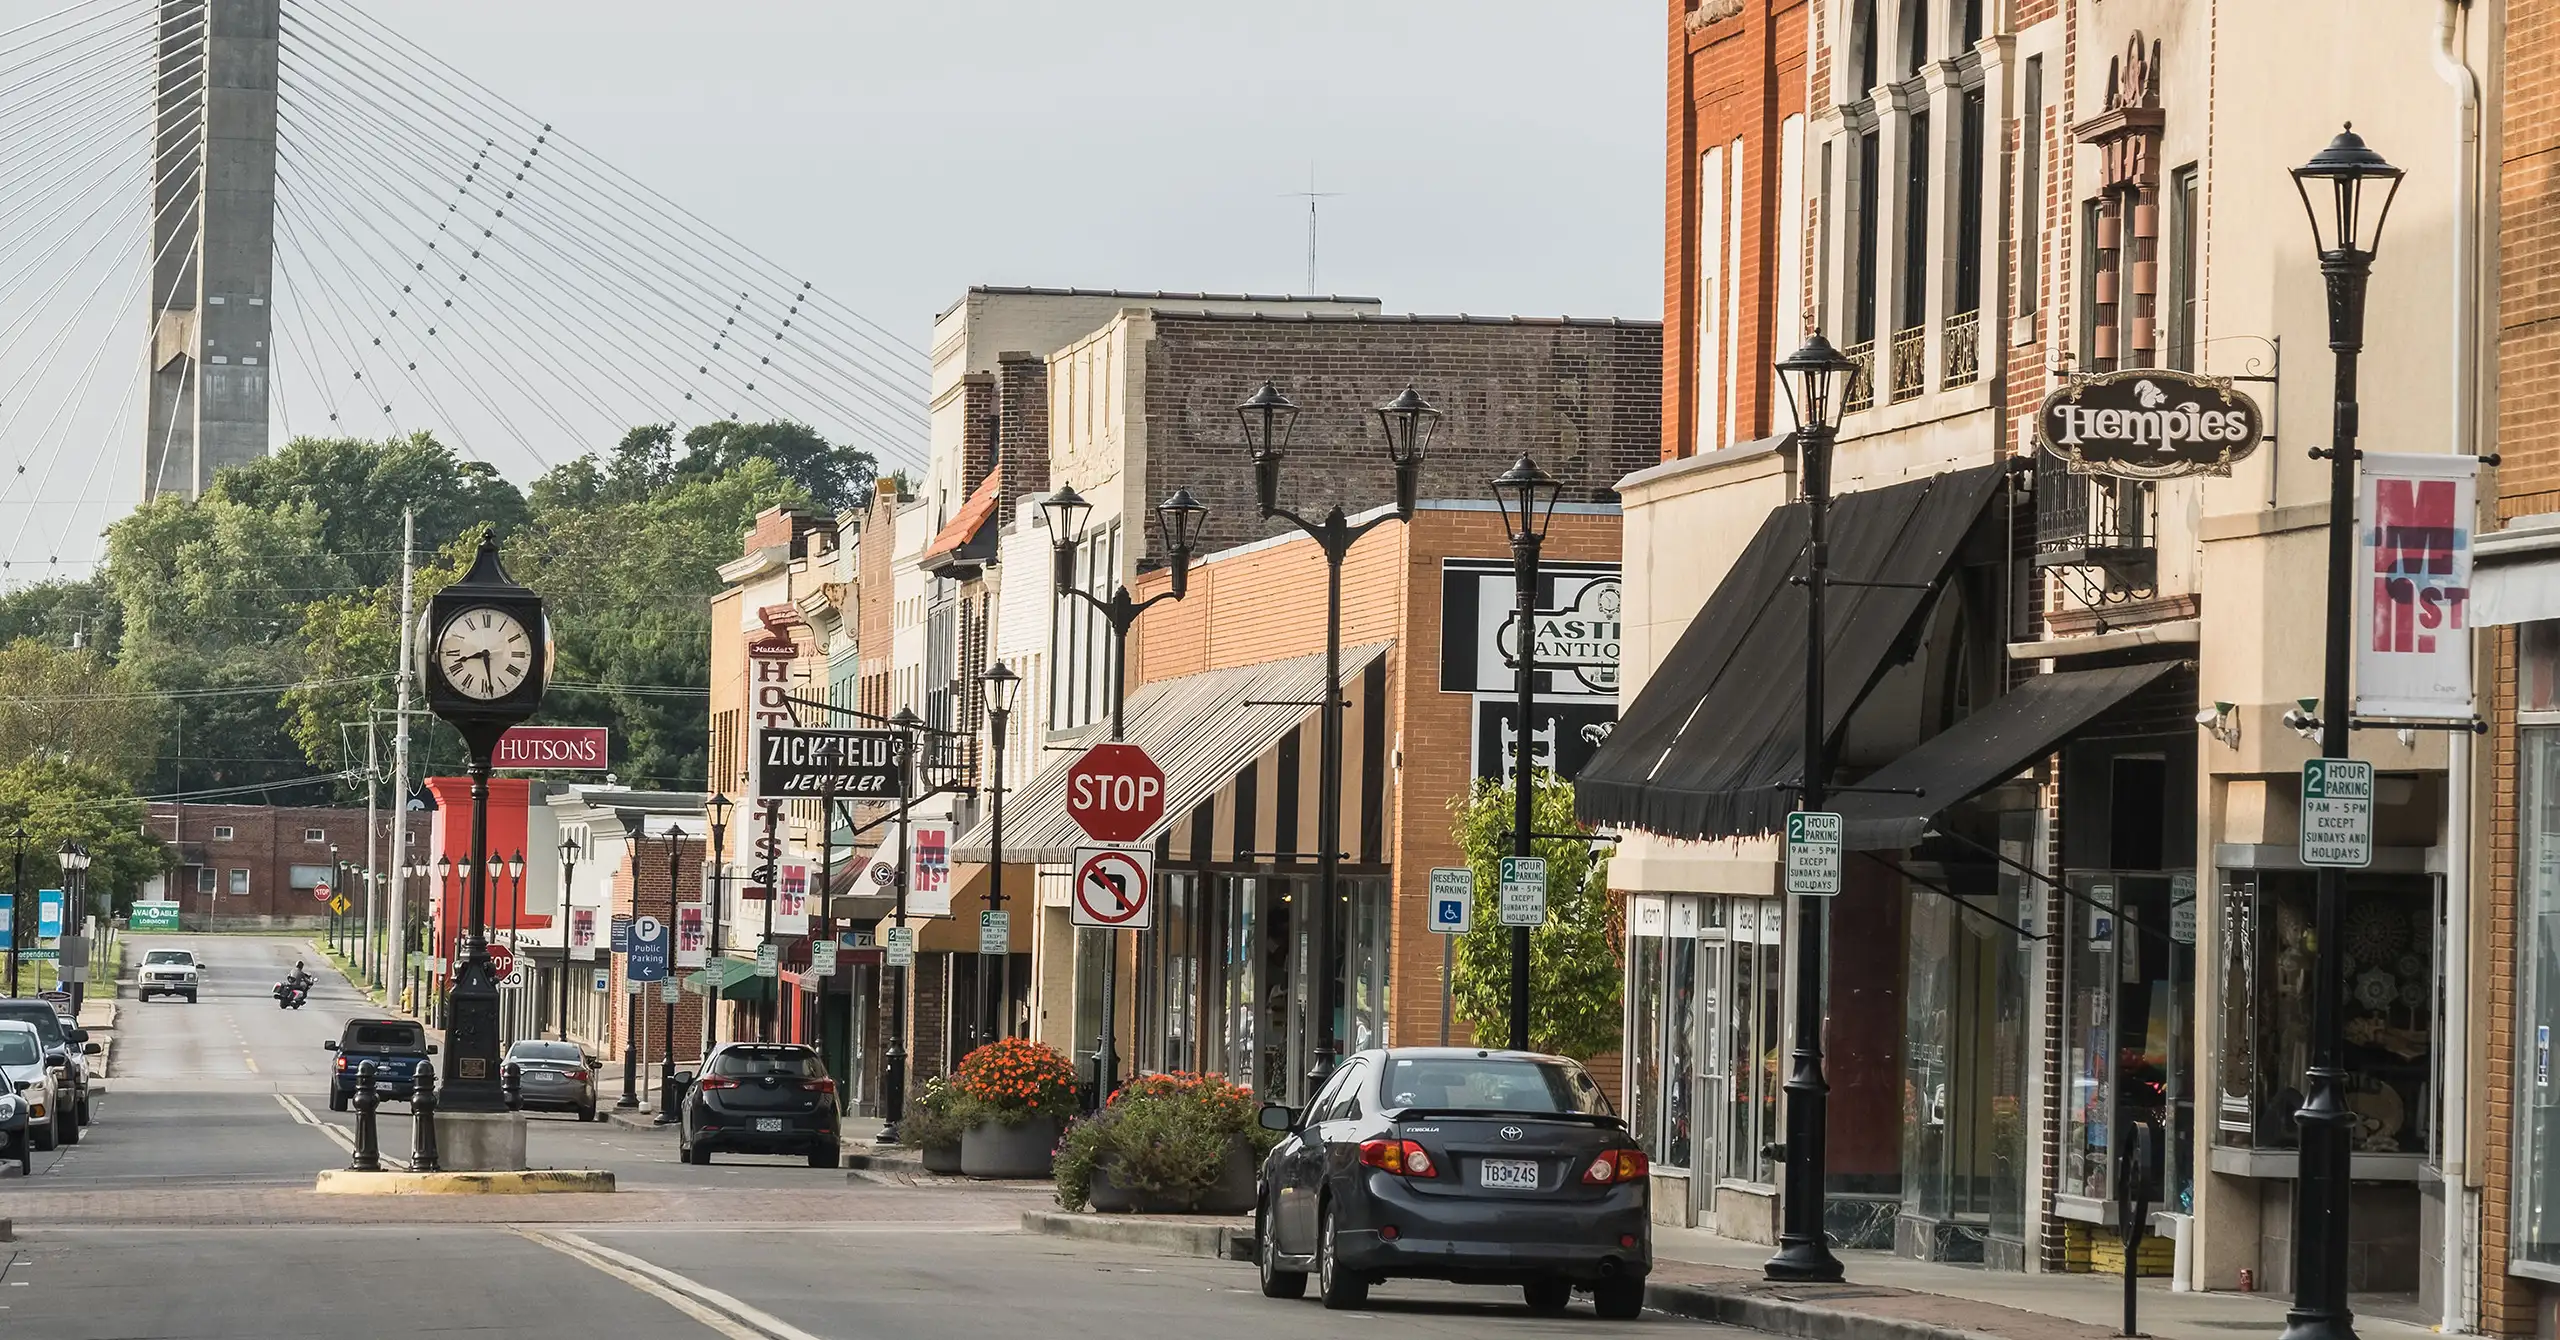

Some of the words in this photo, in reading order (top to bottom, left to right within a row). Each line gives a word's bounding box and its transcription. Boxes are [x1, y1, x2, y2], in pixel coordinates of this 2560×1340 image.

[2053, 402, 2248, 451] Hempies
[500, 737, 596, 761] HUTSON'S
[2329, 765, 2366, 780] HOUR
[2307, 766, 2323, 793] 2
[1073, 774, 1159, 812] STOP
[2326, 781, 2369, 796] PARKING
[1791, 818, 1803, 839] 2
[1808, 817, 1836, 829] HOUR
[2318, 817, 2355, 828] EXCEPT
[1805, 830, 1838, 842] PARKING
[2306, 832, 2346, 844] SUNDAYS
[2349, 834, 2367, 845] AND
[2311, 847, 2360, 859] HOLIDAYS
[1518, 861, 1541, 871] HOUR
[1800, 857, 1828, 867] EXCEPT
[1504, 863, 1514, 880] 2
[1515, 871, 1543, 882] PARKING
[1790, 868, 1821, 878] SUNDAYS
[1824, 870, 1837, 879] AND
[1433, 873, 1470, 885] RESERVED
[1794, 880, 1832, 890] HOLIDAYS
[1435, 884, 1467, 896] PARKING
[1511, 895, 1535, 903] EXCEPT
[1503, 904, 1529, 912] SUNDAYS
[1531, 905, 1543, 913] AND
[982, 914, 990, 925] 2
[1506, 914, 1539, 922] HOLIDAYS
[635, 944, 661, 953] Public
[632, 954, 664, 964] Parking
